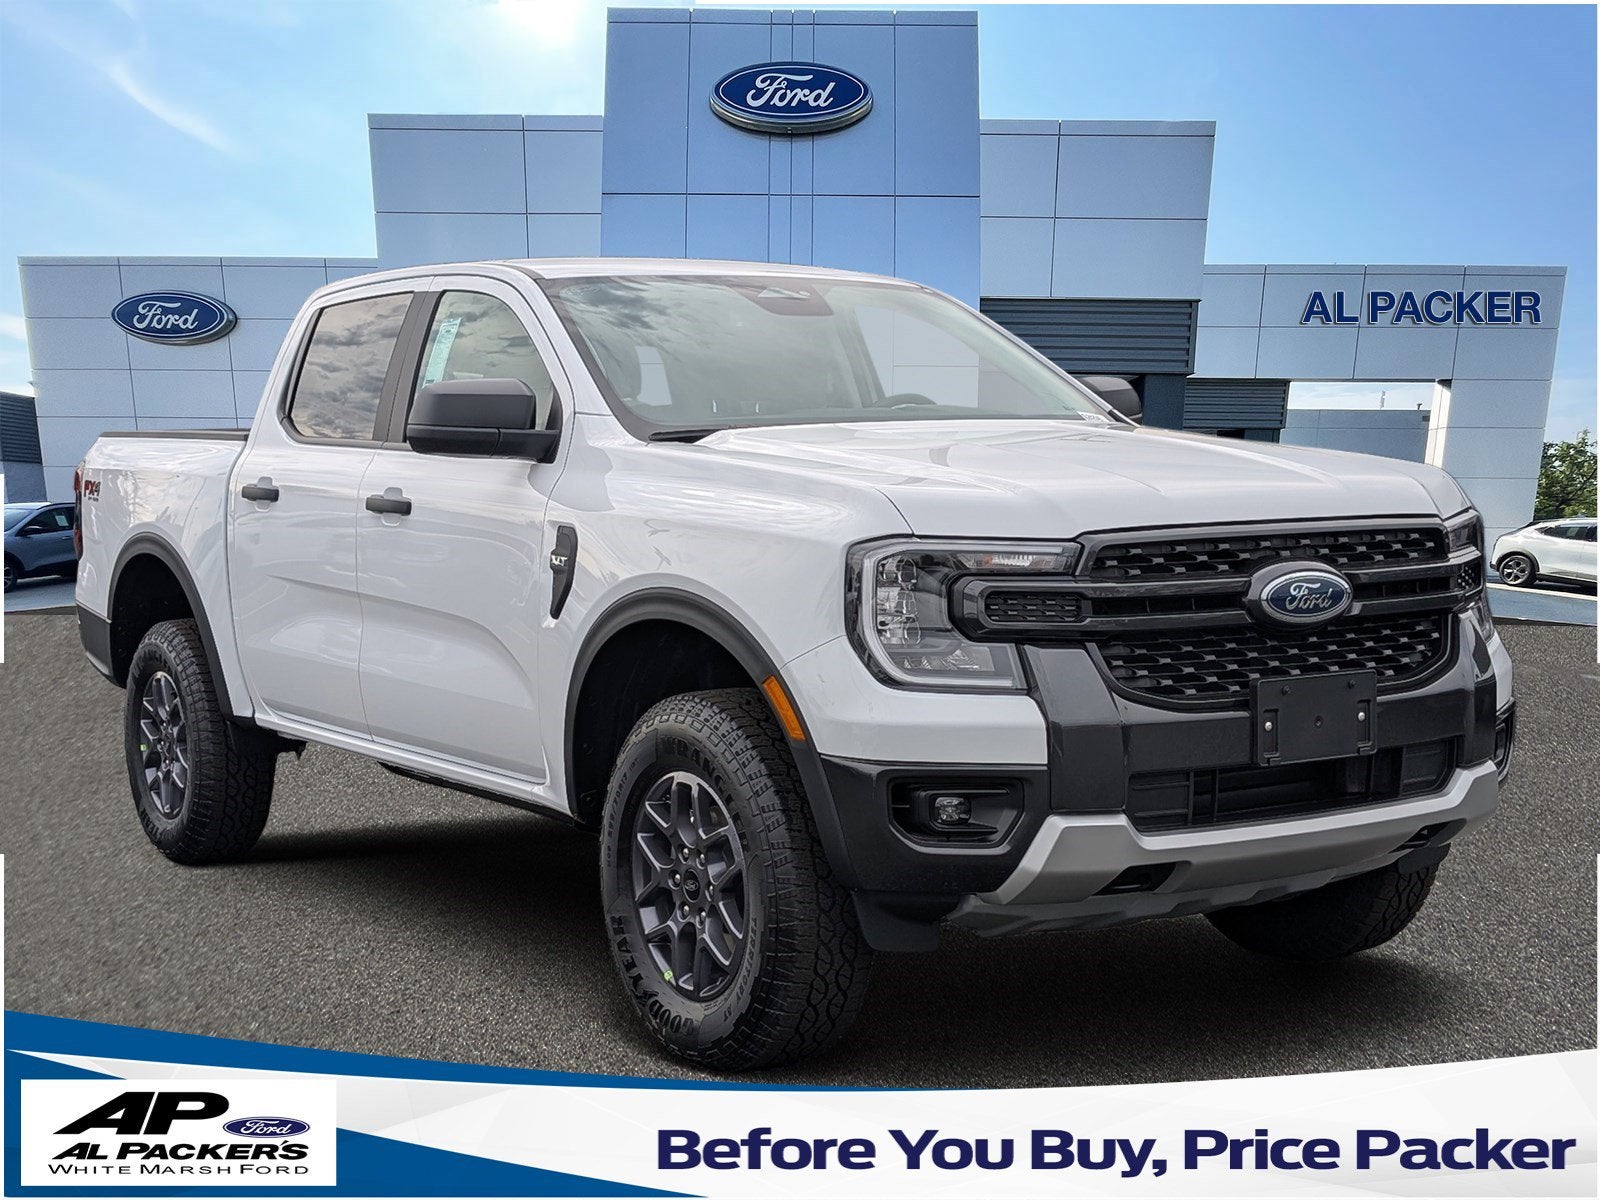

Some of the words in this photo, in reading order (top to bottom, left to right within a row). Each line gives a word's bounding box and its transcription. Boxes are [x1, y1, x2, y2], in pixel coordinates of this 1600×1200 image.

[746, 73, 836, 107] Ford
[133, 301, 199, 329] Ford
[1301, 291, 1359, 324] AL
[1369, 290, 1542, 324] PACKER
[1285, 582, 1333, 610] Ford
